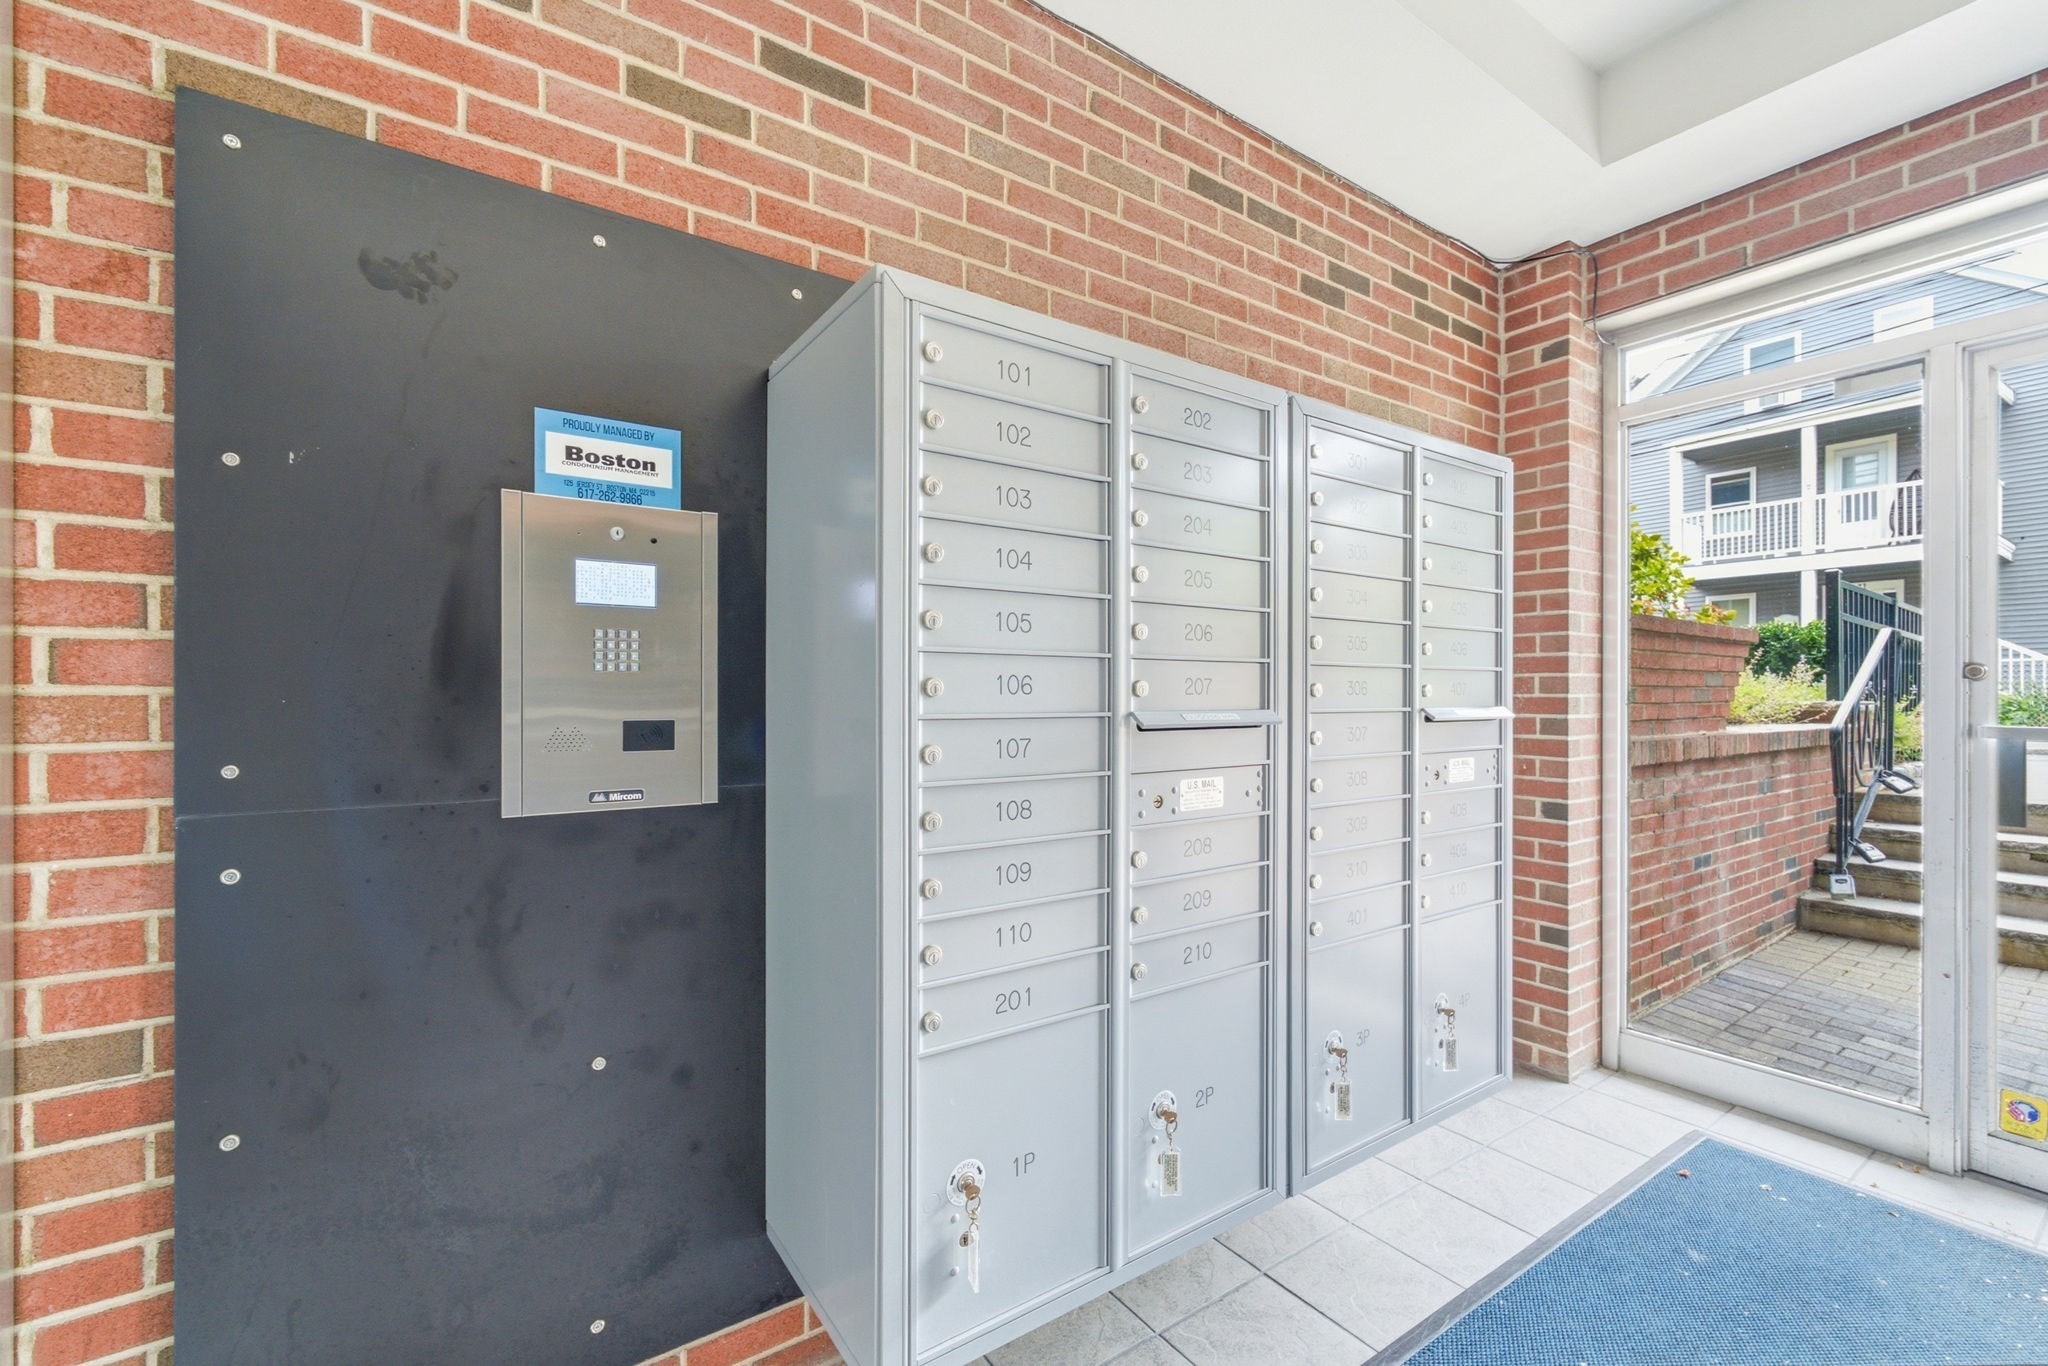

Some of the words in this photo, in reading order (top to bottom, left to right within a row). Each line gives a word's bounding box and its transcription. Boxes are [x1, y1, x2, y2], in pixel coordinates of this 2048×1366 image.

[998, 360, 1031, 387] 101
[562, 418, 601, 433] PROUDLY
[603, 424, 642, 440] MANAGED
[644, 430, 655, 441] BY
[1184, 408, 1212, 431] 202
[996, 422, 1032, 449] 102
[562, 460, 614, 472] CONDOMINIUM
[614, 467, 660, 478] MANAGEMENT
[565, 445, 656, 472] Boston
[1346, 452, 1368, 472] 301
[1184, 462, 1212, 484] 203
[577, 488, 643, 506] 617-262-9966
[606, 484, 627, 492] BOSTON
[996, 486, 1032, 510] 103
[1184, 516, 1212, 537] 204
[996, 548, 1032, 571] 104
[1346, 542, 1368, 562] 303
[1184, 568, 1212, 590] 205
[1346, 590, 1368, 607] 304
[995, 611, 1032, 634] 105
[1184, 623, 1212, 643] 206
[1346, 634, 1368, 652] 305
[996, 674, 1033, 696] 106
[1184, 677, 1212, 697] 207
[1346, 680, 1368, 696] 306
[1346, 726, 1368, 742] 307
[996, 738, 1032, 760] 107
[1187, 780, 1200, 790] U.S.
[1202, 778, 1217, 788] MAIL
[1346, 771, 1368, 787] 308
[996, 800, 1032, 822] 108
[1346, 816, 1368, 833] 309
[1184, 837, 1212, 858] 208
[996, 861, 1032, 886] 109
[1346, 861, 1368, 878] 310
[1184, 890, 1212, 912] 209
[1346, 908, 1368, 926] 401
[996, 922, 1032, 948] 110
[1184, 942, 1212, 966] 210
[995, 987, 1032, 1015] 201
[1356, 1028, 1370, 1047] 3P
[1195, 1086, 1214, 1108] 2P
[1013, 1151, 1036, 1178] 1P
